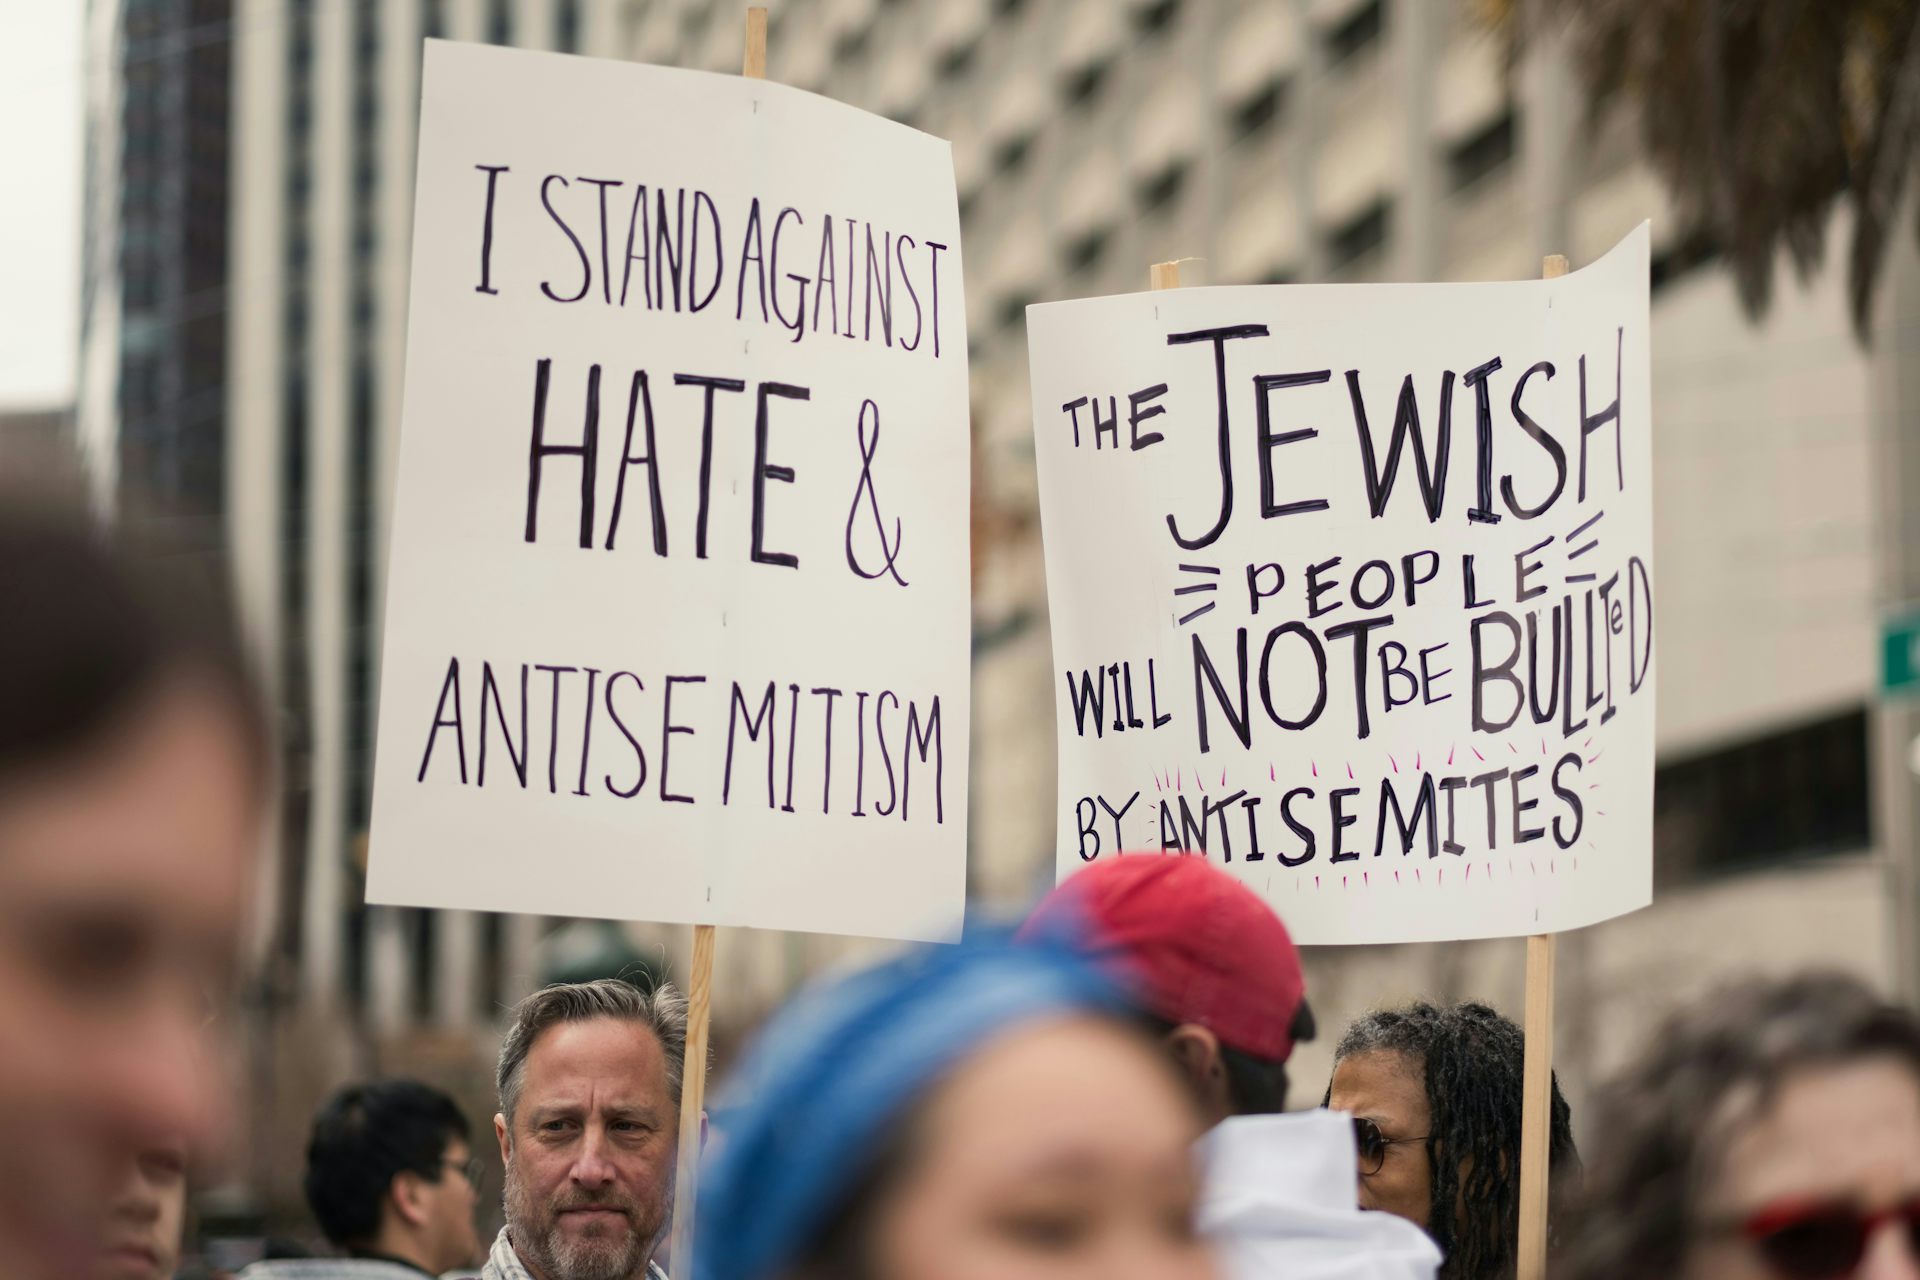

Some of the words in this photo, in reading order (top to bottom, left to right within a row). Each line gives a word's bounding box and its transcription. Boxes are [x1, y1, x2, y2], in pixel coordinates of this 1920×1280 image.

[474, 164, 510, 296] I
[540, 174, 723, 314] STAND
[736, 197, 948, 359] AGAINST
[524, 358, 811, 570] HATE
[845, 398, 910, 588] &
[1062, 382, 1169, 452] THE
[1166, 324, 1624, 551] JEWISH
[1246, 535, 1555, 619] PEOPLE
[417, 656, 943, 825] ANTISEMITISM
[1066, 657, 1172, 739] WILL
[1191, 614, 1395, 754] NOT
[1378, 640, 1453, 713] BE
[1076, 791, 1140, 862] BY
[1159, 752, 1585, 867] ANTISEMITES
